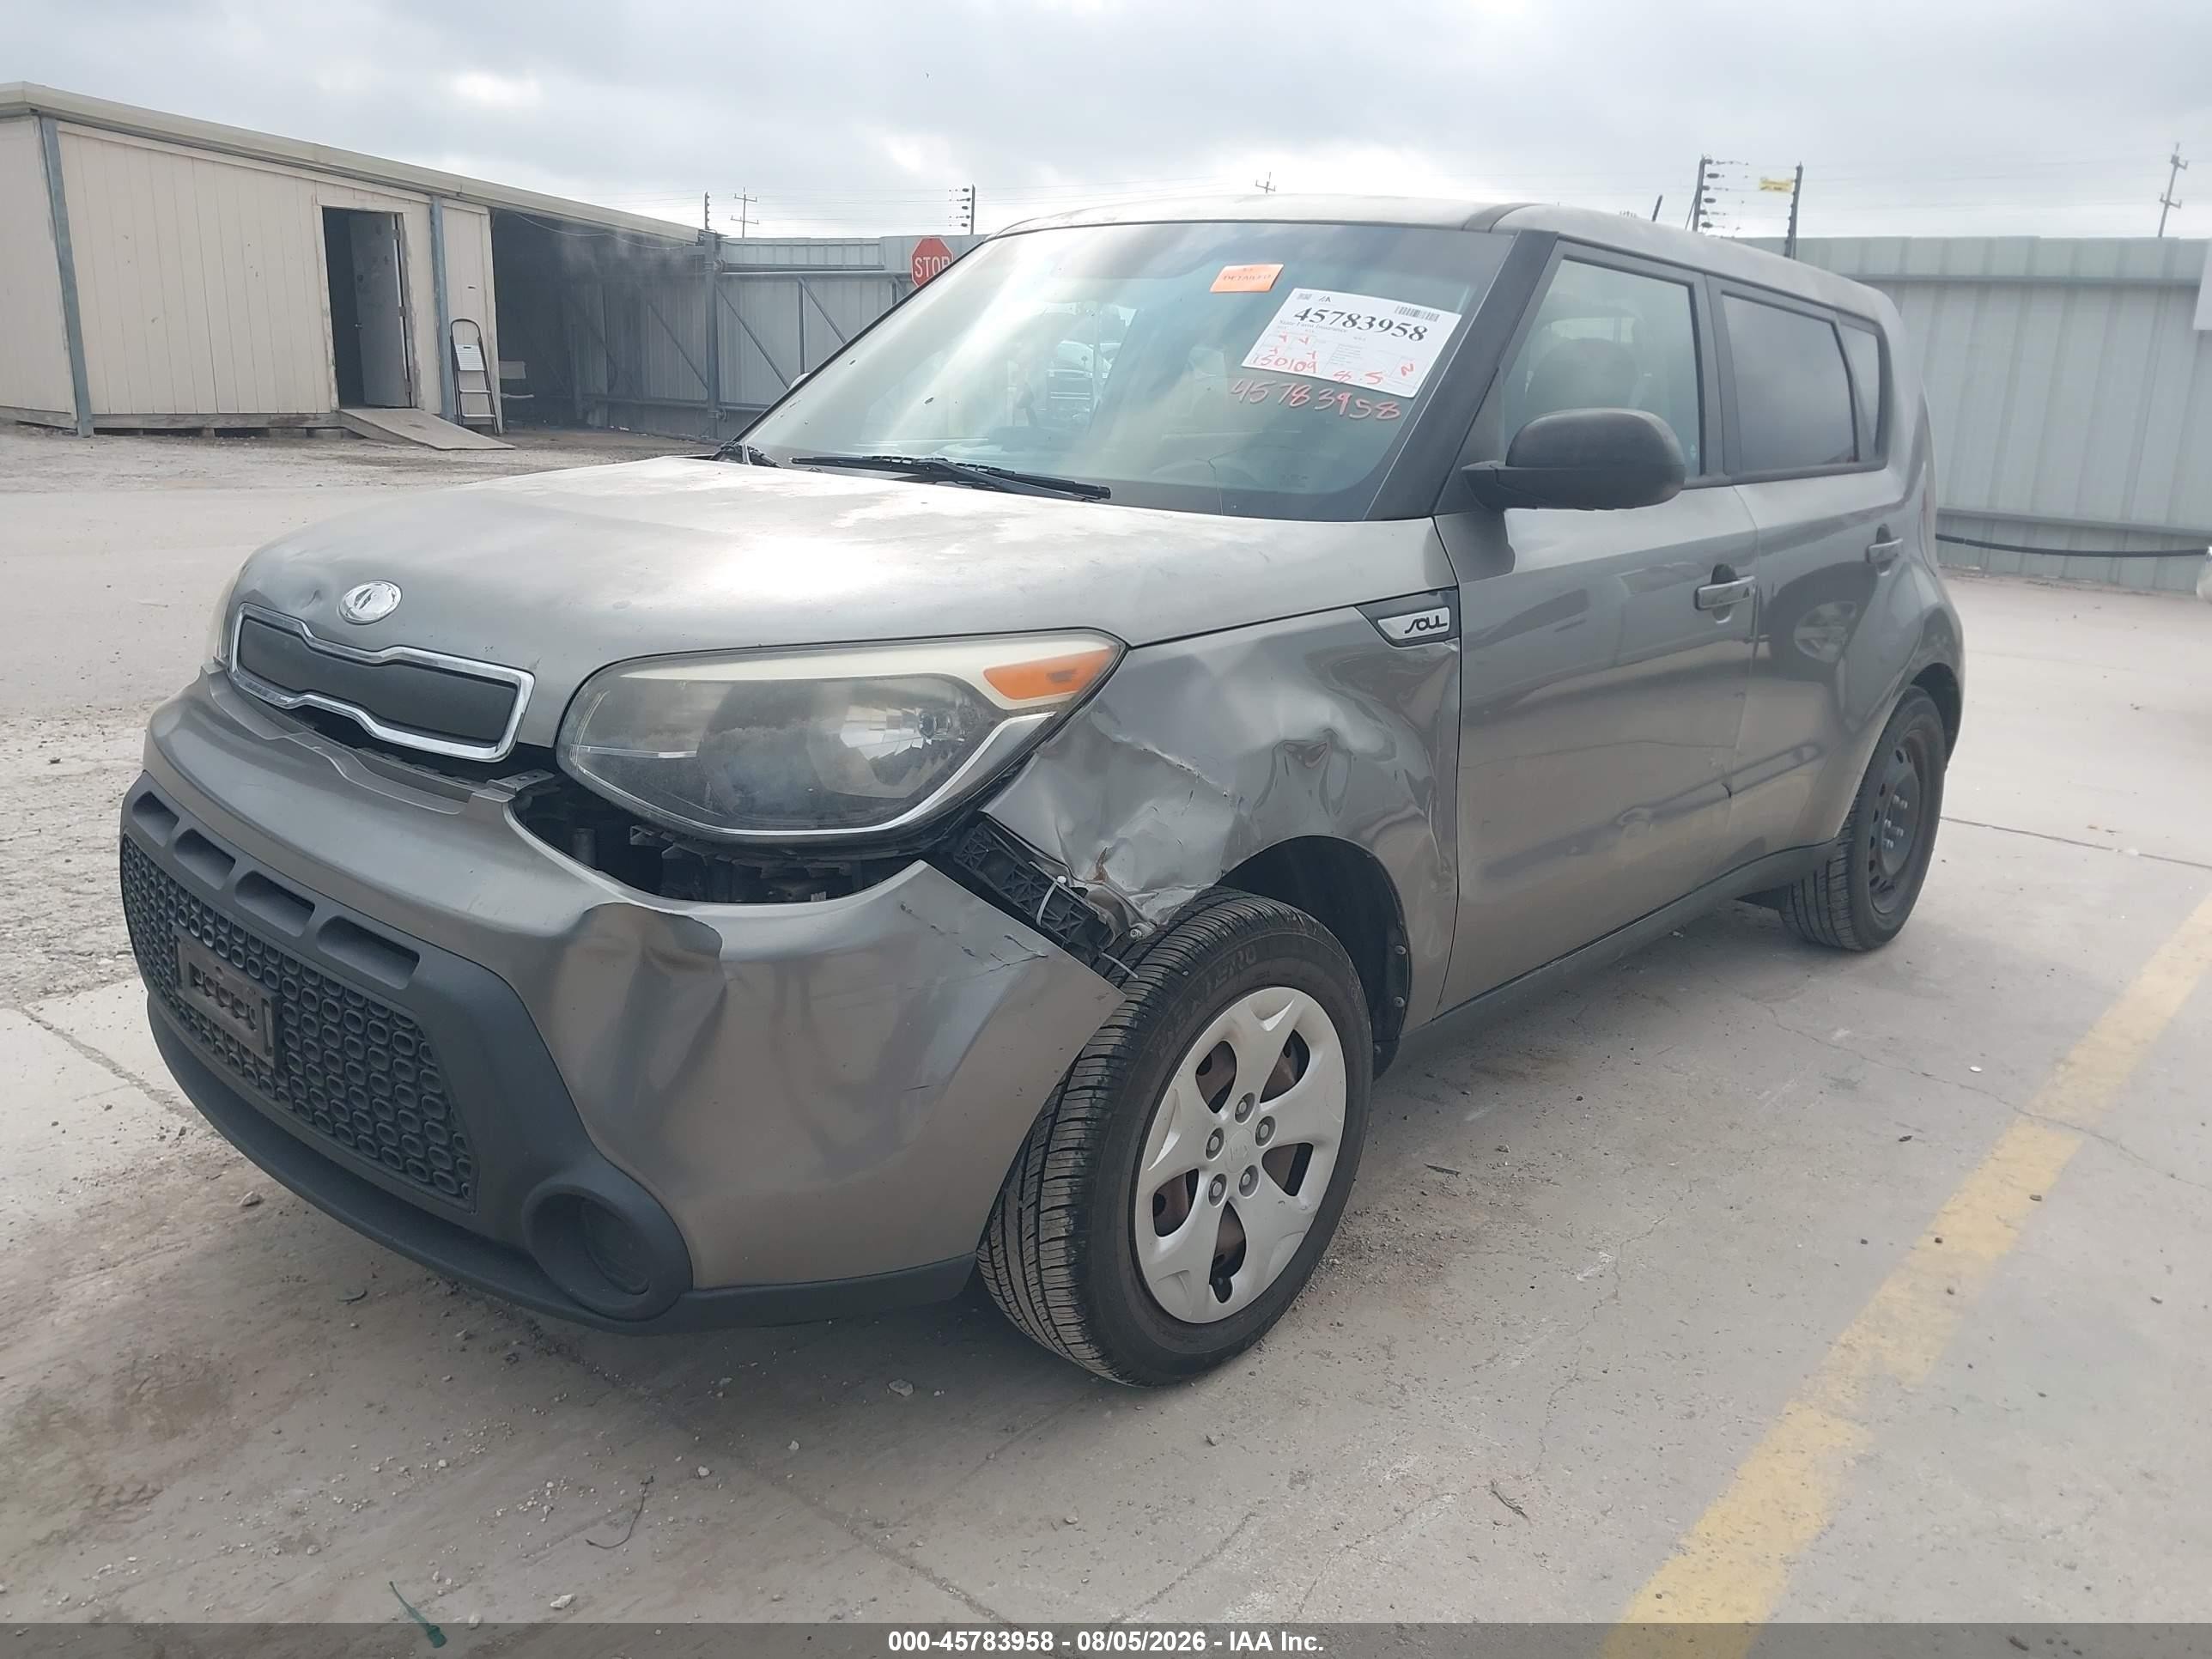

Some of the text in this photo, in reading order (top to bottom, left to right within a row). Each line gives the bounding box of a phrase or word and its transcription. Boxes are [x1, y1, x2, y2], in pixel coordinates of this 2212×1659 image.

[915, 256, 950, 277] STOP
[1294, 307, 1427, 341] 45783958
[1230, 379, 1401, 420] 45783958
